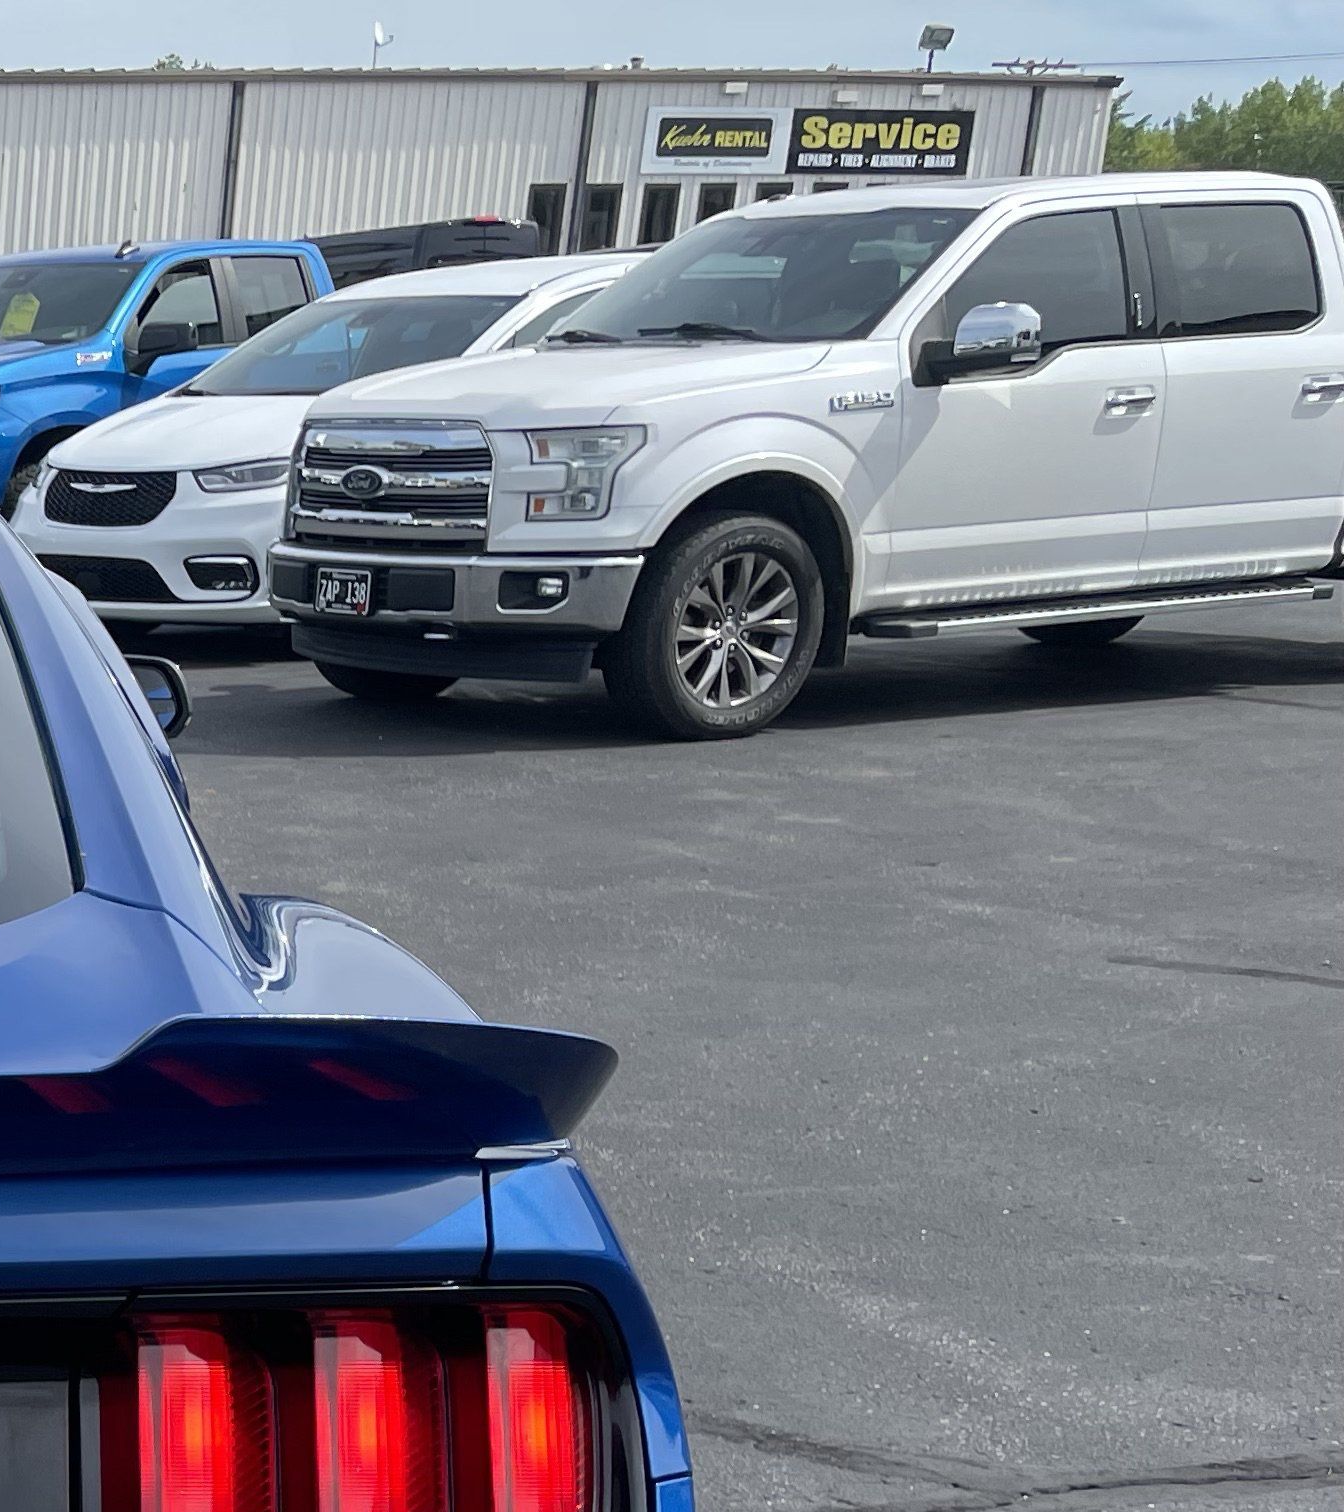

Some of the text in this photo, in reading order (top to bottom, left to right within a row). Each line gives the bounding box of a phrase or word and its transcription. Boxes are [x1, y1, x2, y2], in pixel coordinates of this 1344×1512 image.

[660, 123, 768, 150] Kuehn RENTAL
[800, 115, 961, 150] Service
[319, 579, 367, 605] ZAP 138
